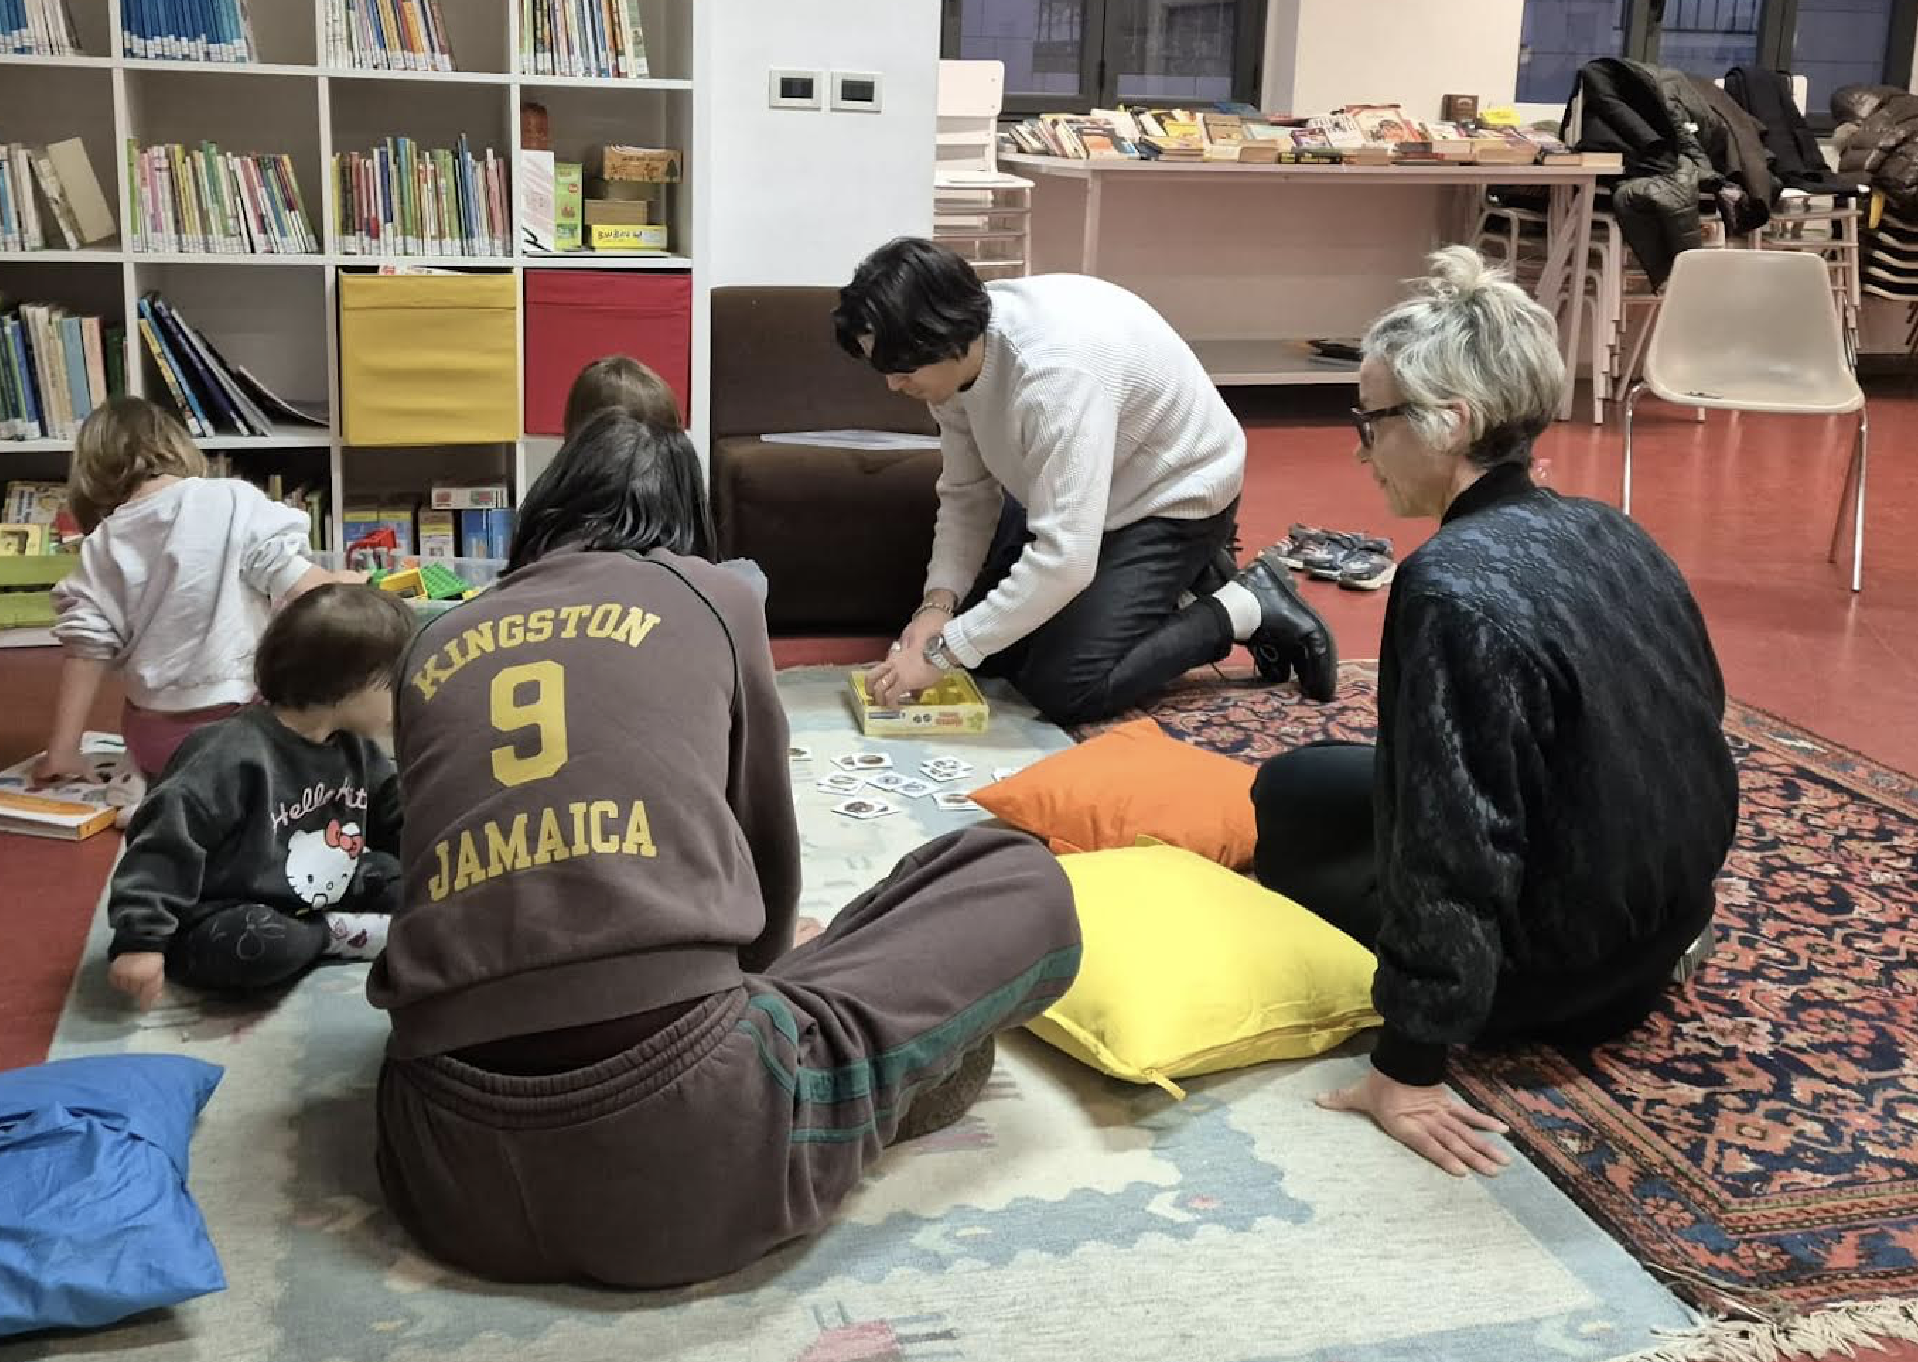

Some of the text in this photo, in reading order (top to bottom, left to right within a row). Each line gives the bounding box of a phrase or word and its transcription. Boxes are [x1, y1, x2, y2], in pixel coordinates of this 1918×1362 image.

[412, 604, 660, 700] KINGSTON
[490, 660, 569, 788] 9
[271, 783, 335, 831] Hello
[430, 801, 657, 901] JAMAICA
